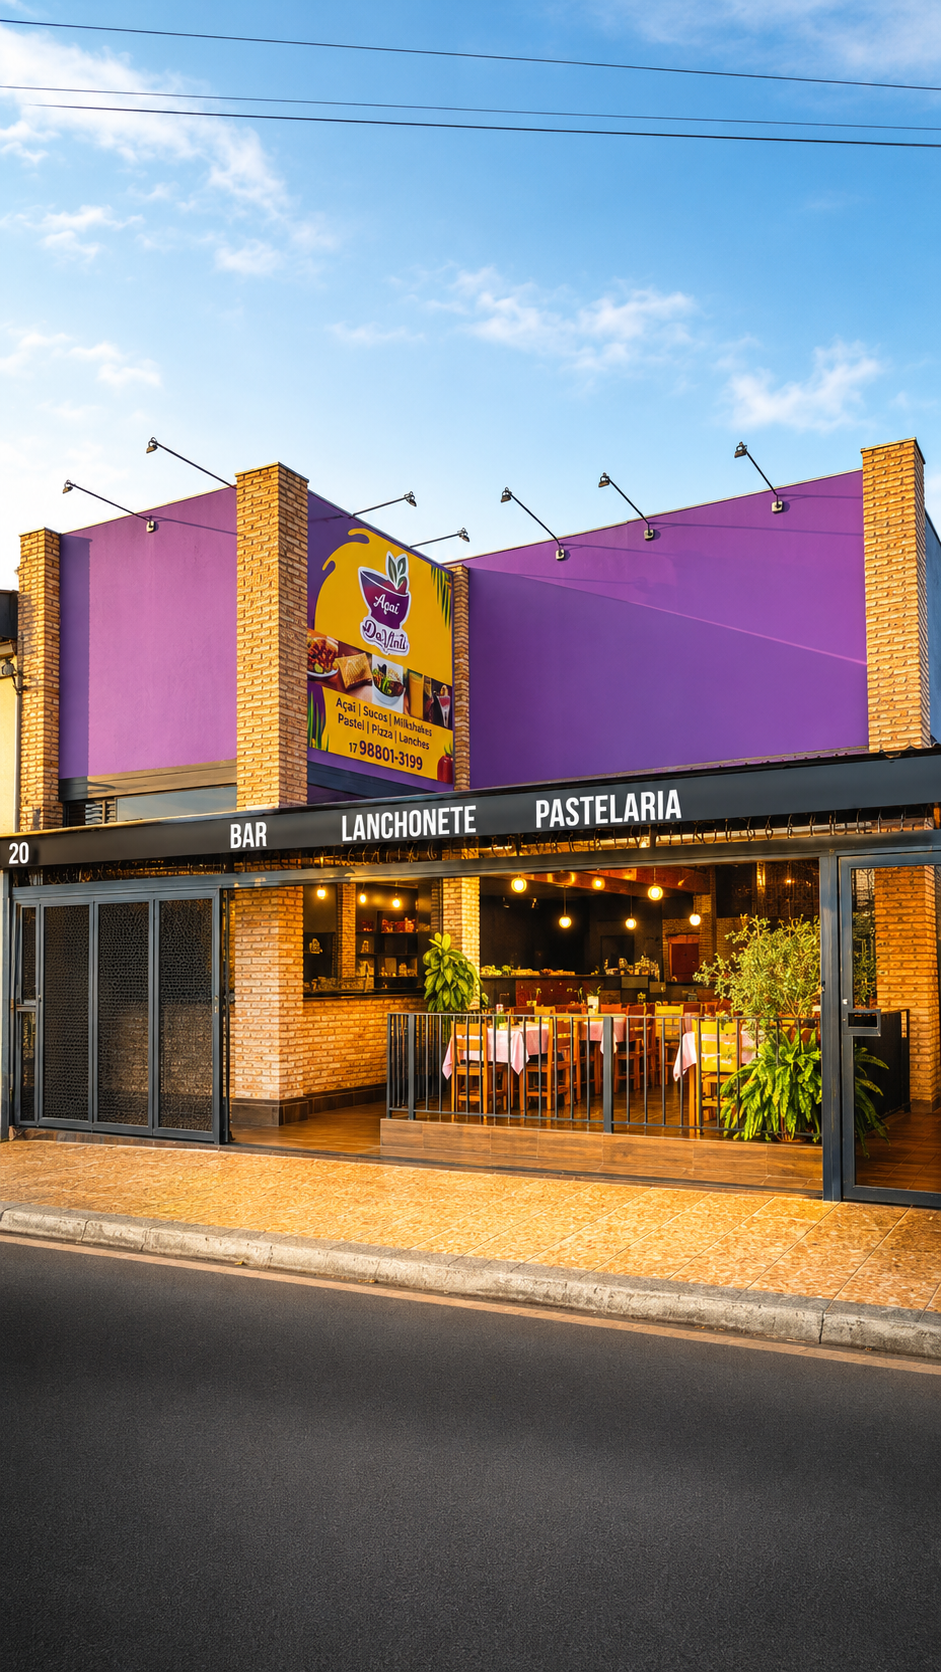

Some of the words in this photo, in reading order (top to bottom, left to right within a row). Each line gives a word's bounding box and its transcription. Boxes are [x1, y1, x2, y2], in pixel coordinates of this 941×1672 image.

[373, 594, 400, 615] Açai
[335, 697, 356, 713] Açai
[363, 706, 388, 723] Sucos
[393, 716, 432, 737] Milkshakes
[337, 713, 365, 731] Pastel
[371, 724, 393, 739] Pizza
[399, 732, 430, 750] Lanches
[349, 742, 358, 753] 17
[359, 740, 423, 770] 98801-3199
[230, 822, 267, 849] BAR
[341, 805, 476, 842] LANCHONETE
[535, 789, 682, 828] PASTELARIA
[8, 842, 30, 864] 20
